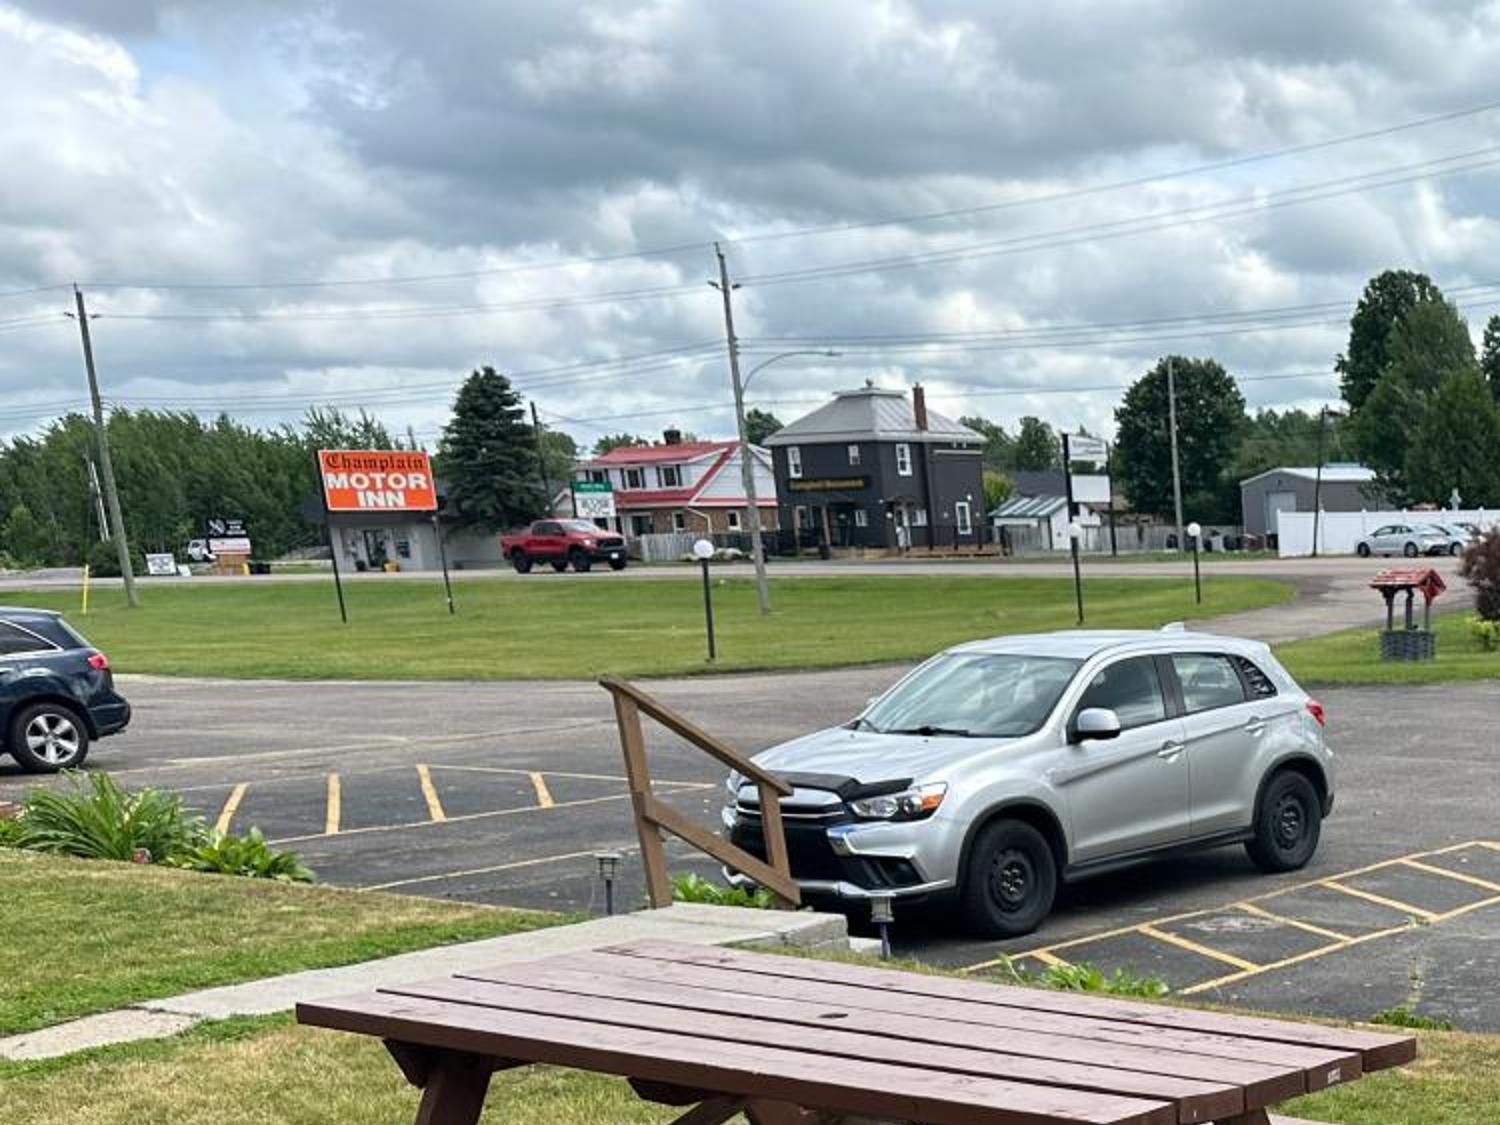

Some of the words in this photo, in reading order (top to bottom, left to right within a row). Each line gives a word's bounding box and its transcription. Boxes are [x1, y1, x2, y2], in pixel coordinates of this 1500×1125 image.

[326, 453, 423, 471] Champlain
[326, 472, 428, 489] MOTOR
[357, 490, 406, 507] INN
